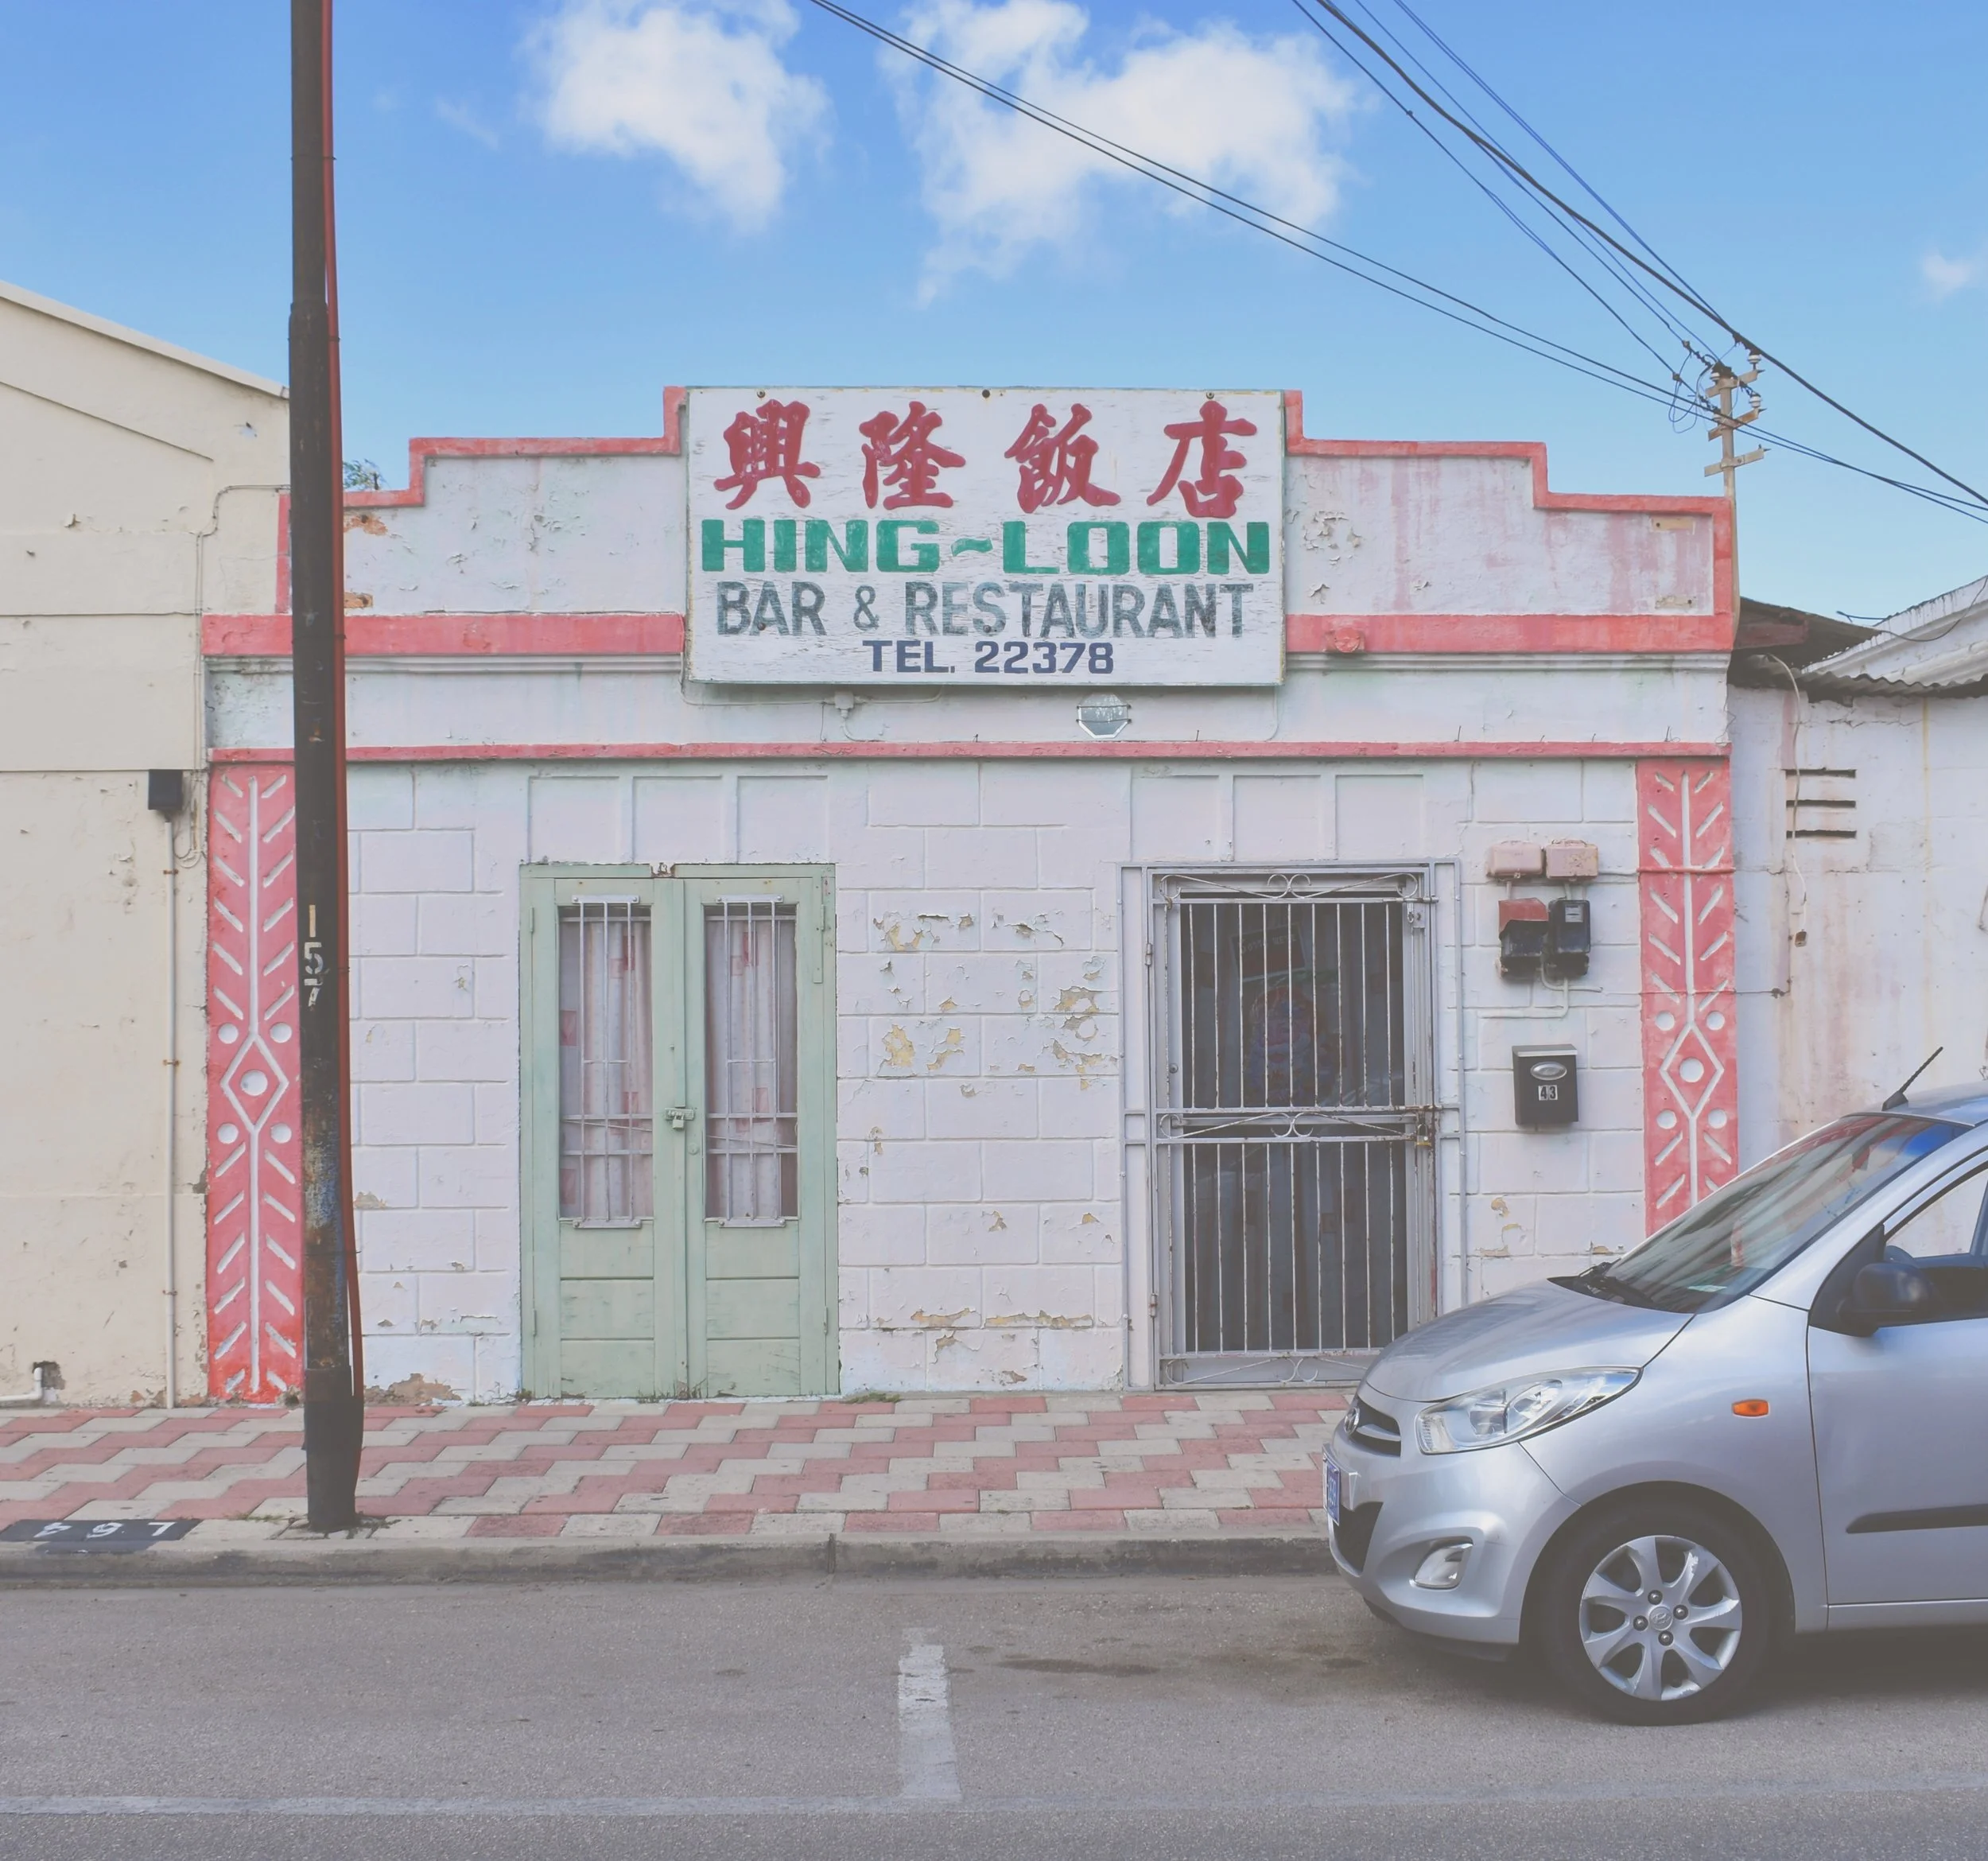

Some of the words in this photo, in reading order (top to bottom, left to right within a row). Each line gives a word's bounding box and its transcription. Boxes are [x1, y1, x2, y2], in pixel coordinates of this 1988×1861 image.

[713, 399, 1257, 519] 興隆飯店
[716, 581, 827, 636] BAR
[853, 585, 880, 631] &
[905, 581, 1254, 639] RESTAURANT
[862, 639, 956, 674] TEL.
[974, 641, 1115, 674] 22378
[1540, 1086, 1556, 1099] 43
